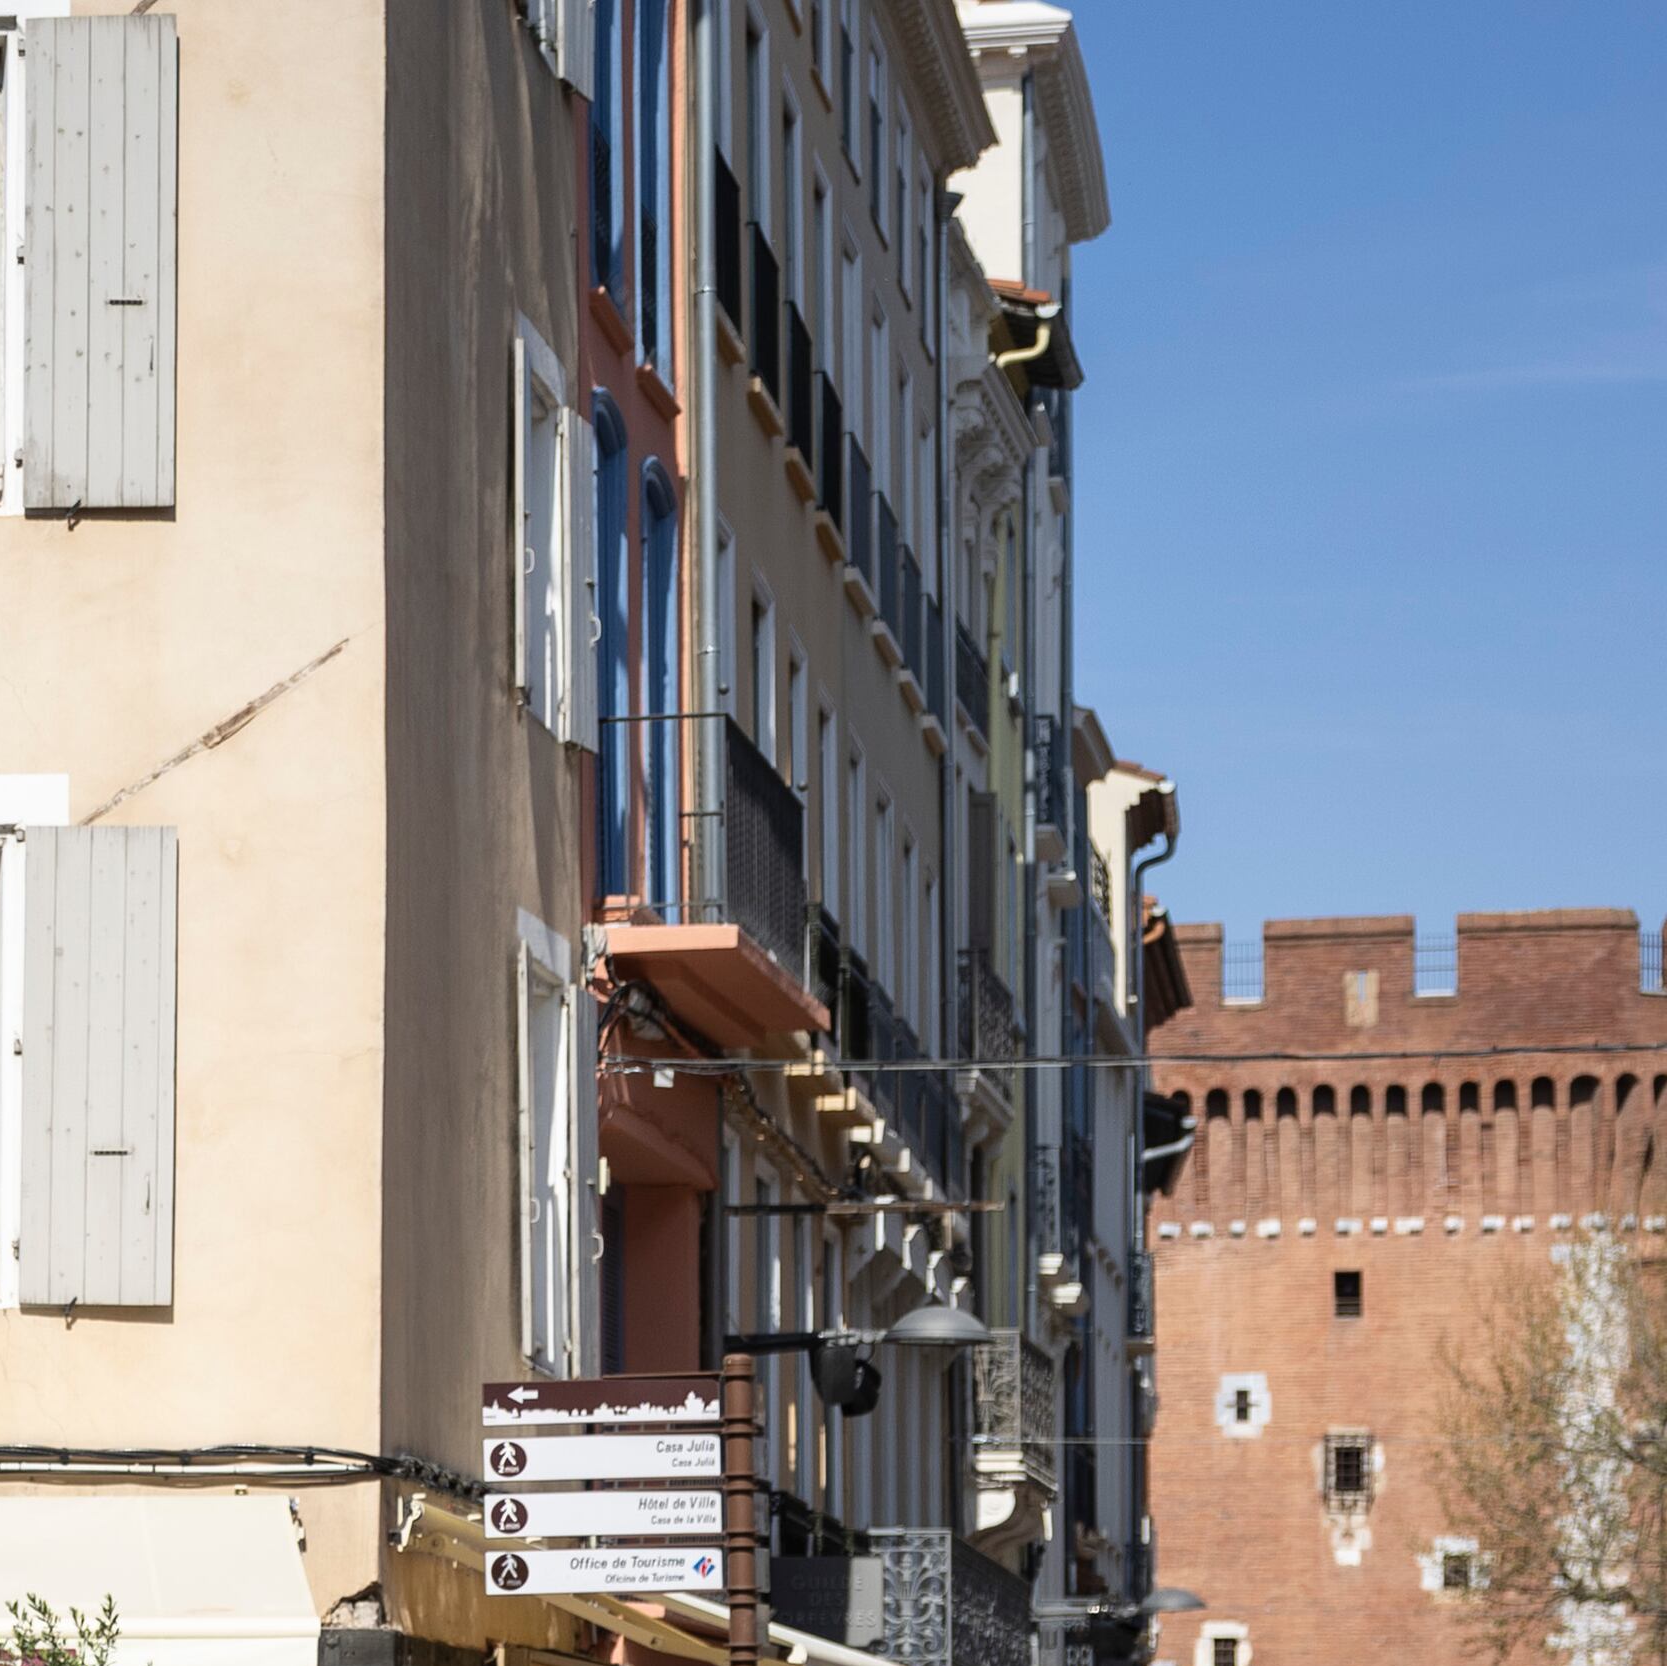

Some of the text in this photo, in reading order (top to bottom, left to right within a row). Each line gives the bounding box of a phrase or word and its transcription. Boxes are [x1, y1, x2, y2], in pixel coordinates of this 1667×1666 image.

[656, 1439, 715, 1453] Casa Julia
[671, 1457, 693, 1468] Casa
[638, 1497, 716, 1511] Hôtel de Ville
[651, 1515, 672, 1525] Casa
[673, 1515, 685, 1525] de
[686, 1515, 696, 1525] la
[570, 1555, 685, 1570] Office de Tourisme
[638, 1573, 649, 1583] de
[652, 1572, 685, 1583] Turisme
